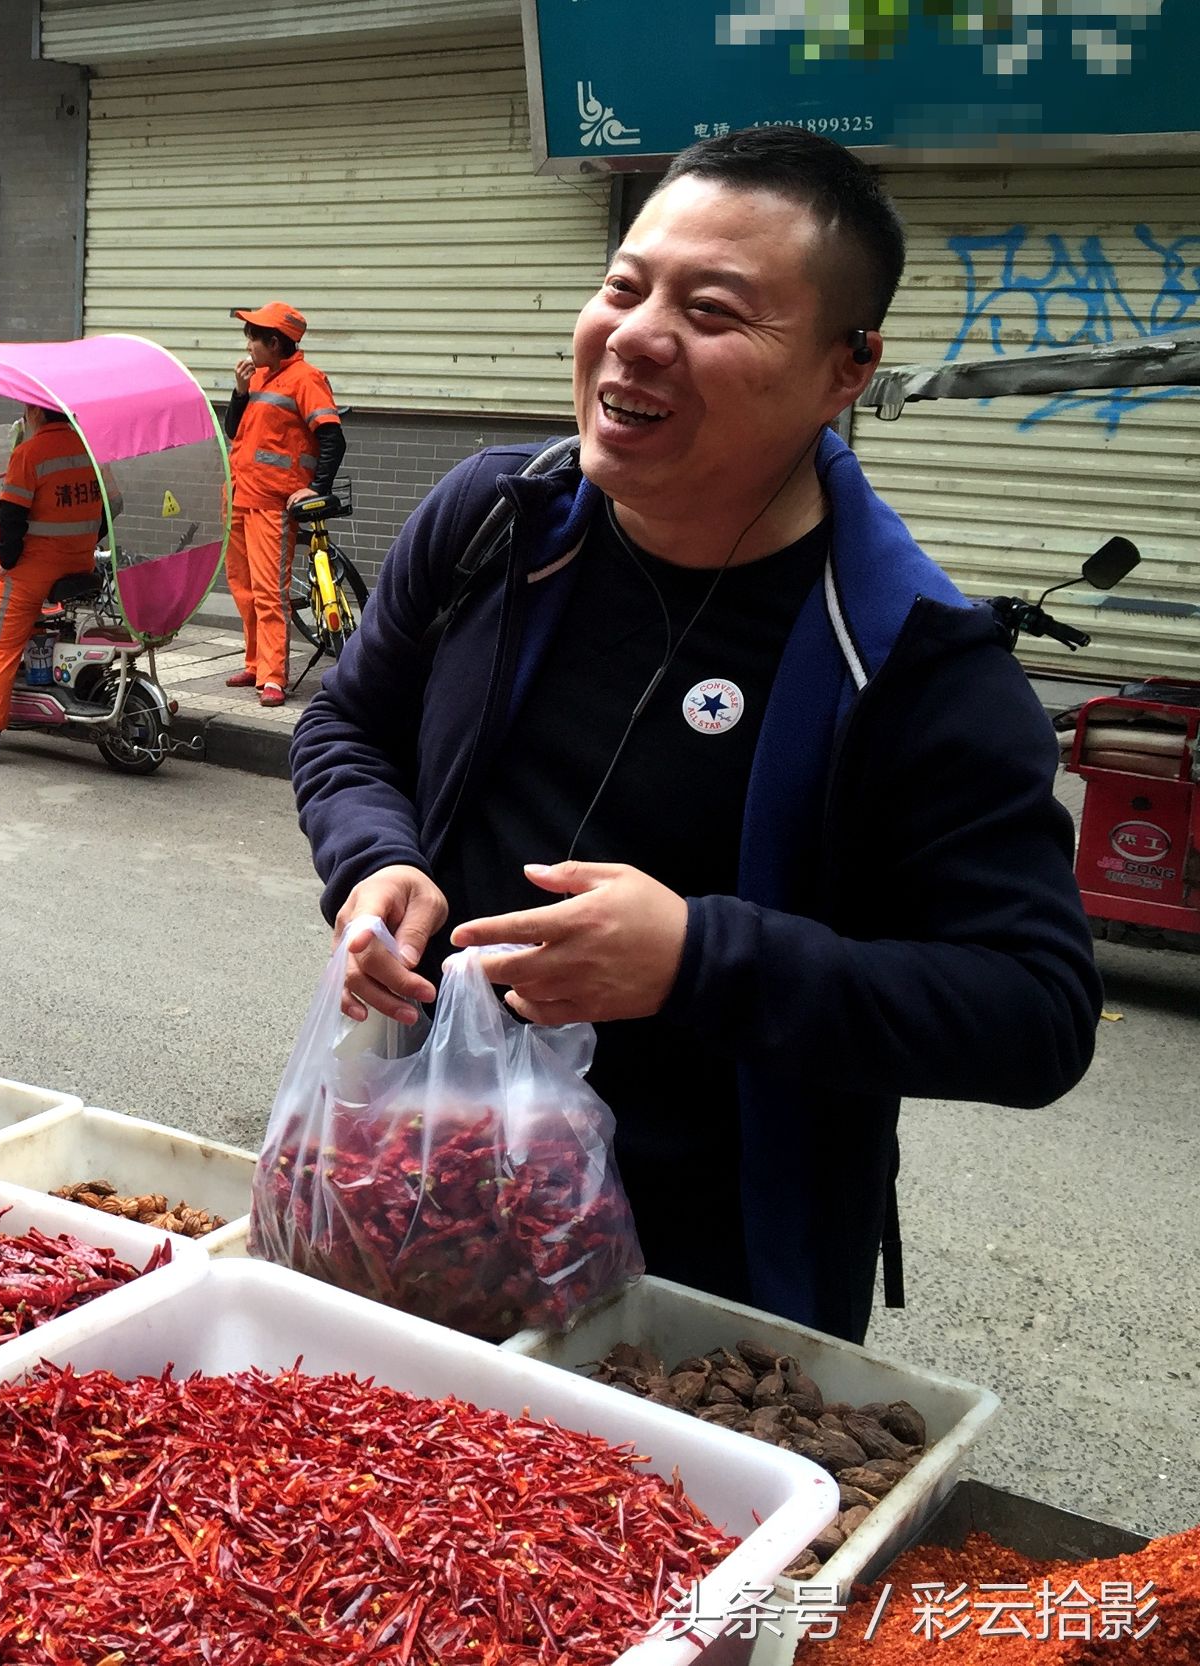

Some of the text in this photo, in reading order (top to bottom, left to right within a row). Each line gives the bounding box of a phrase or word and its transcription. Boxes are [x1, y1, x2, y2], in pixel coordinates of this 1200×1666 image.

[693, 122, 731, 138] 电话
[699, 682, 739, 709] CONVERSE
[687, 707, 722, 730] ALL STAR
